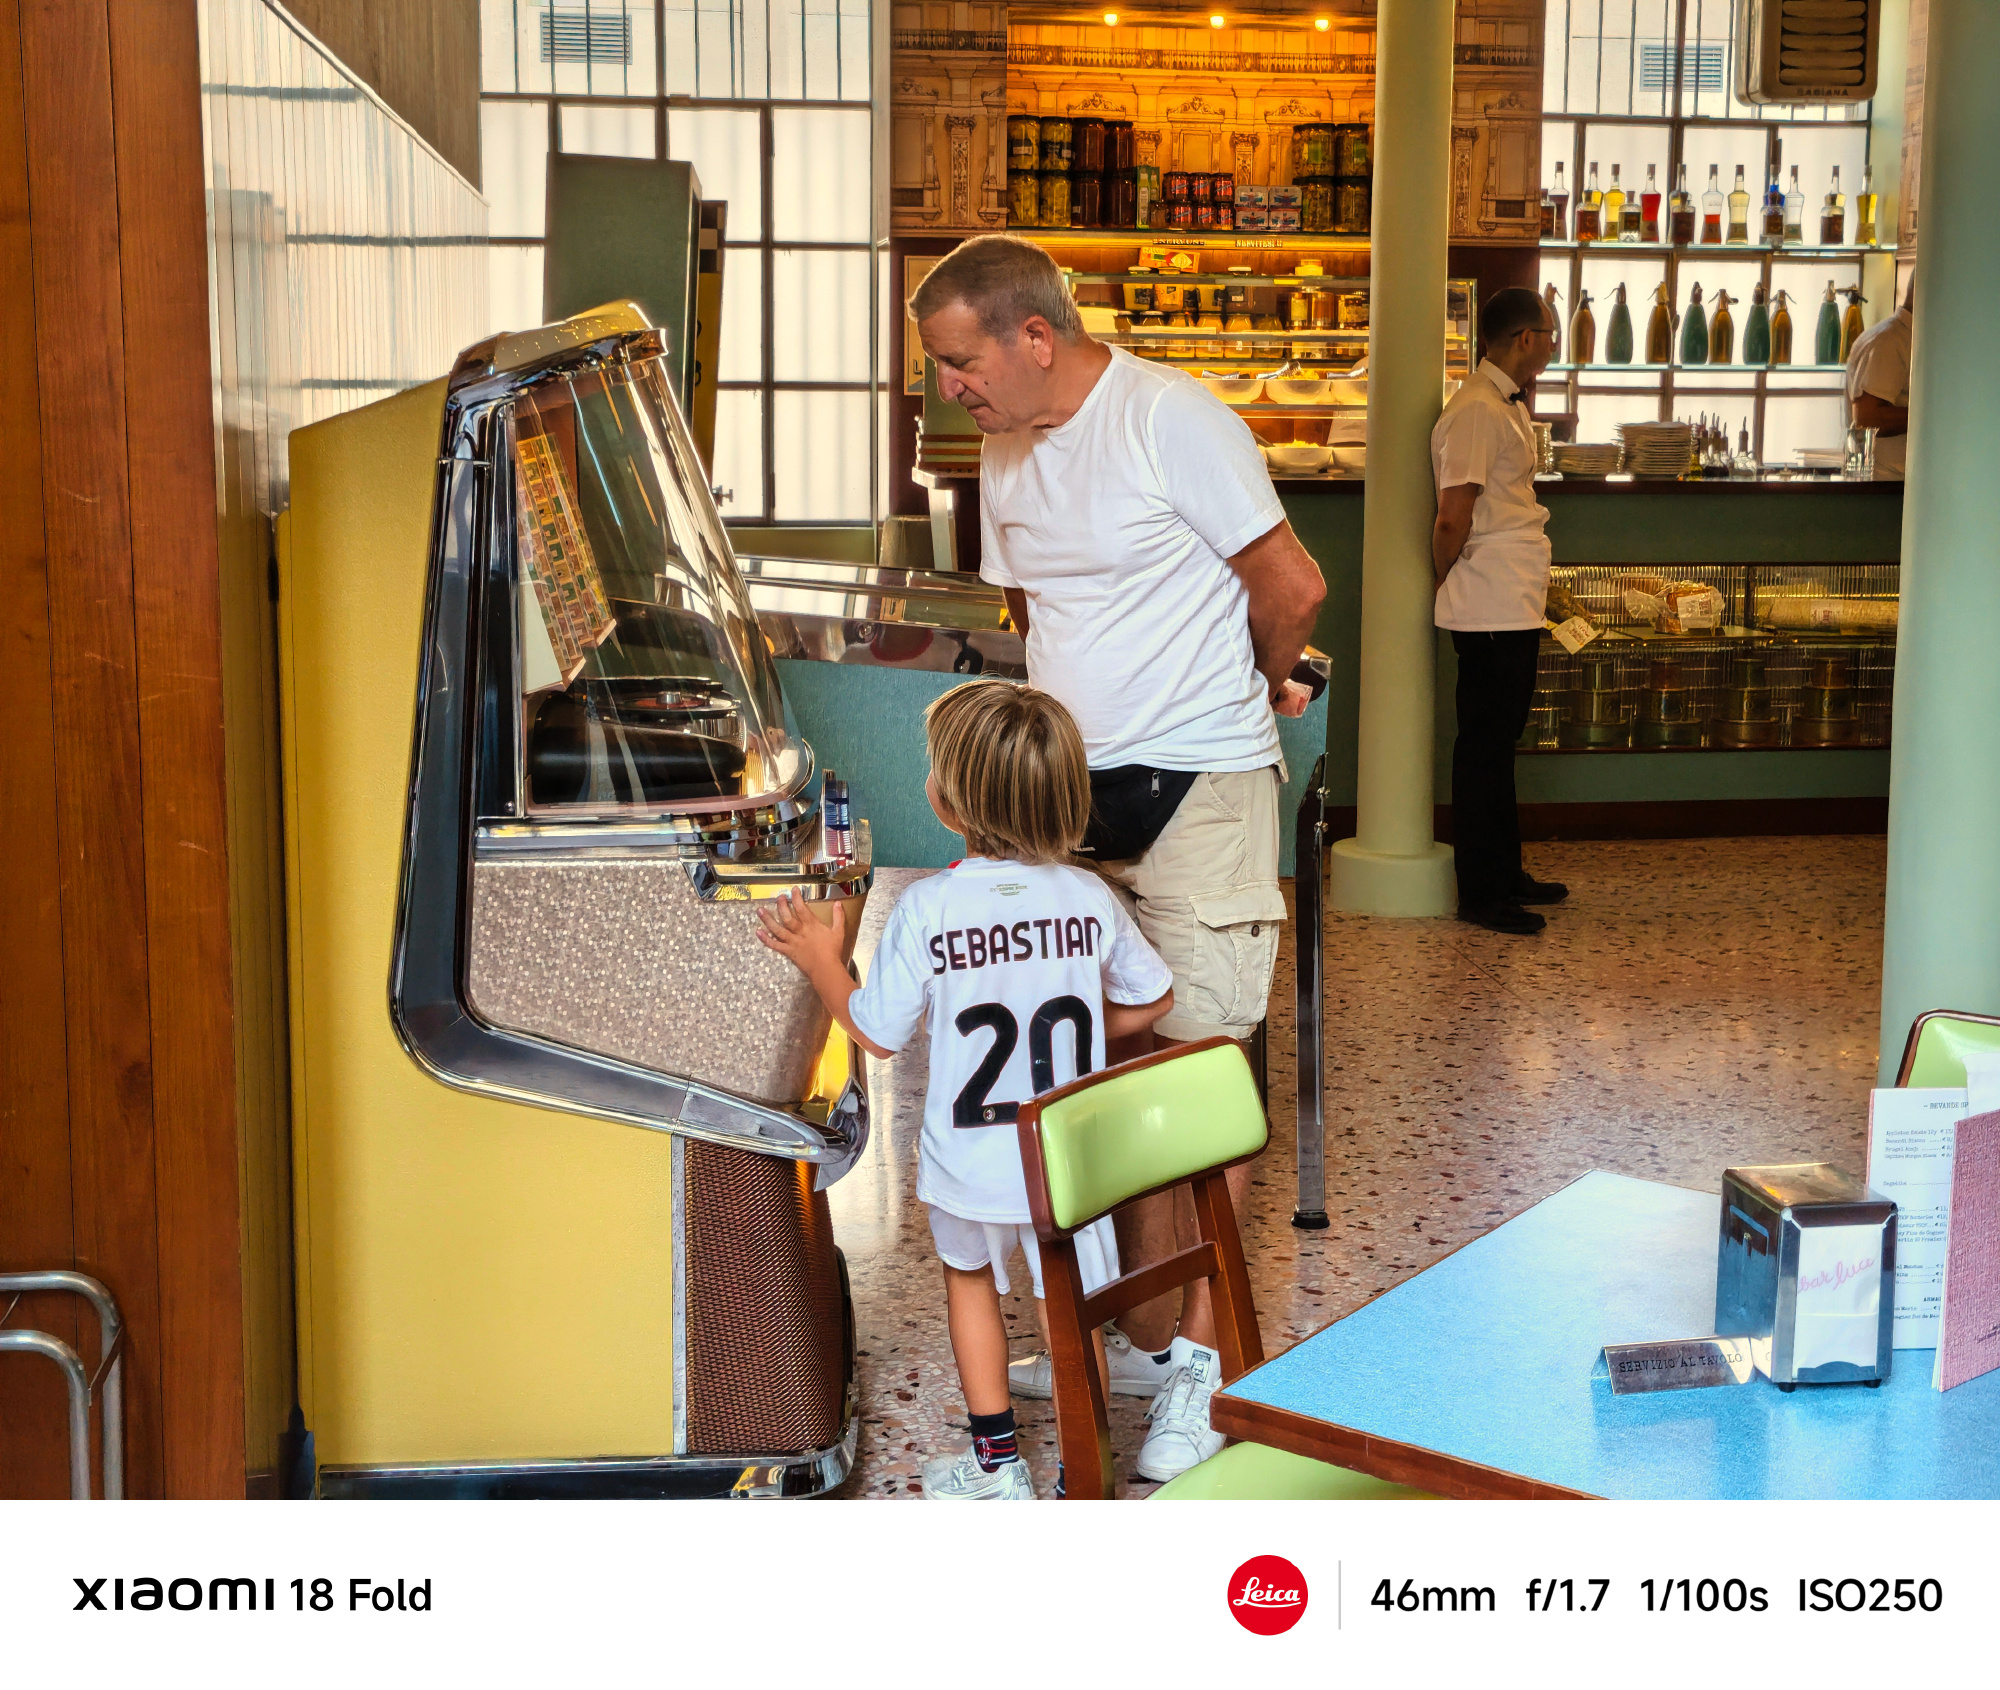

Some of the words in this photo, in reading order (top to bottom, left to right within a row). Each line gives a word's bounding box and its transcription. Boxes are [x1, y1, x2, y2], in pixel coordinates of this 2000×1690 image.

[929, 916, 1102, 976] SEBASTIAN
[953, 994, 1093, 1128] 20
[1618, 1358, 1676, 1374] SERVIZIO
[1680, 1355, 1698, 1368] AL
[1699, 1352, 1744, 1367] TAVOLO
